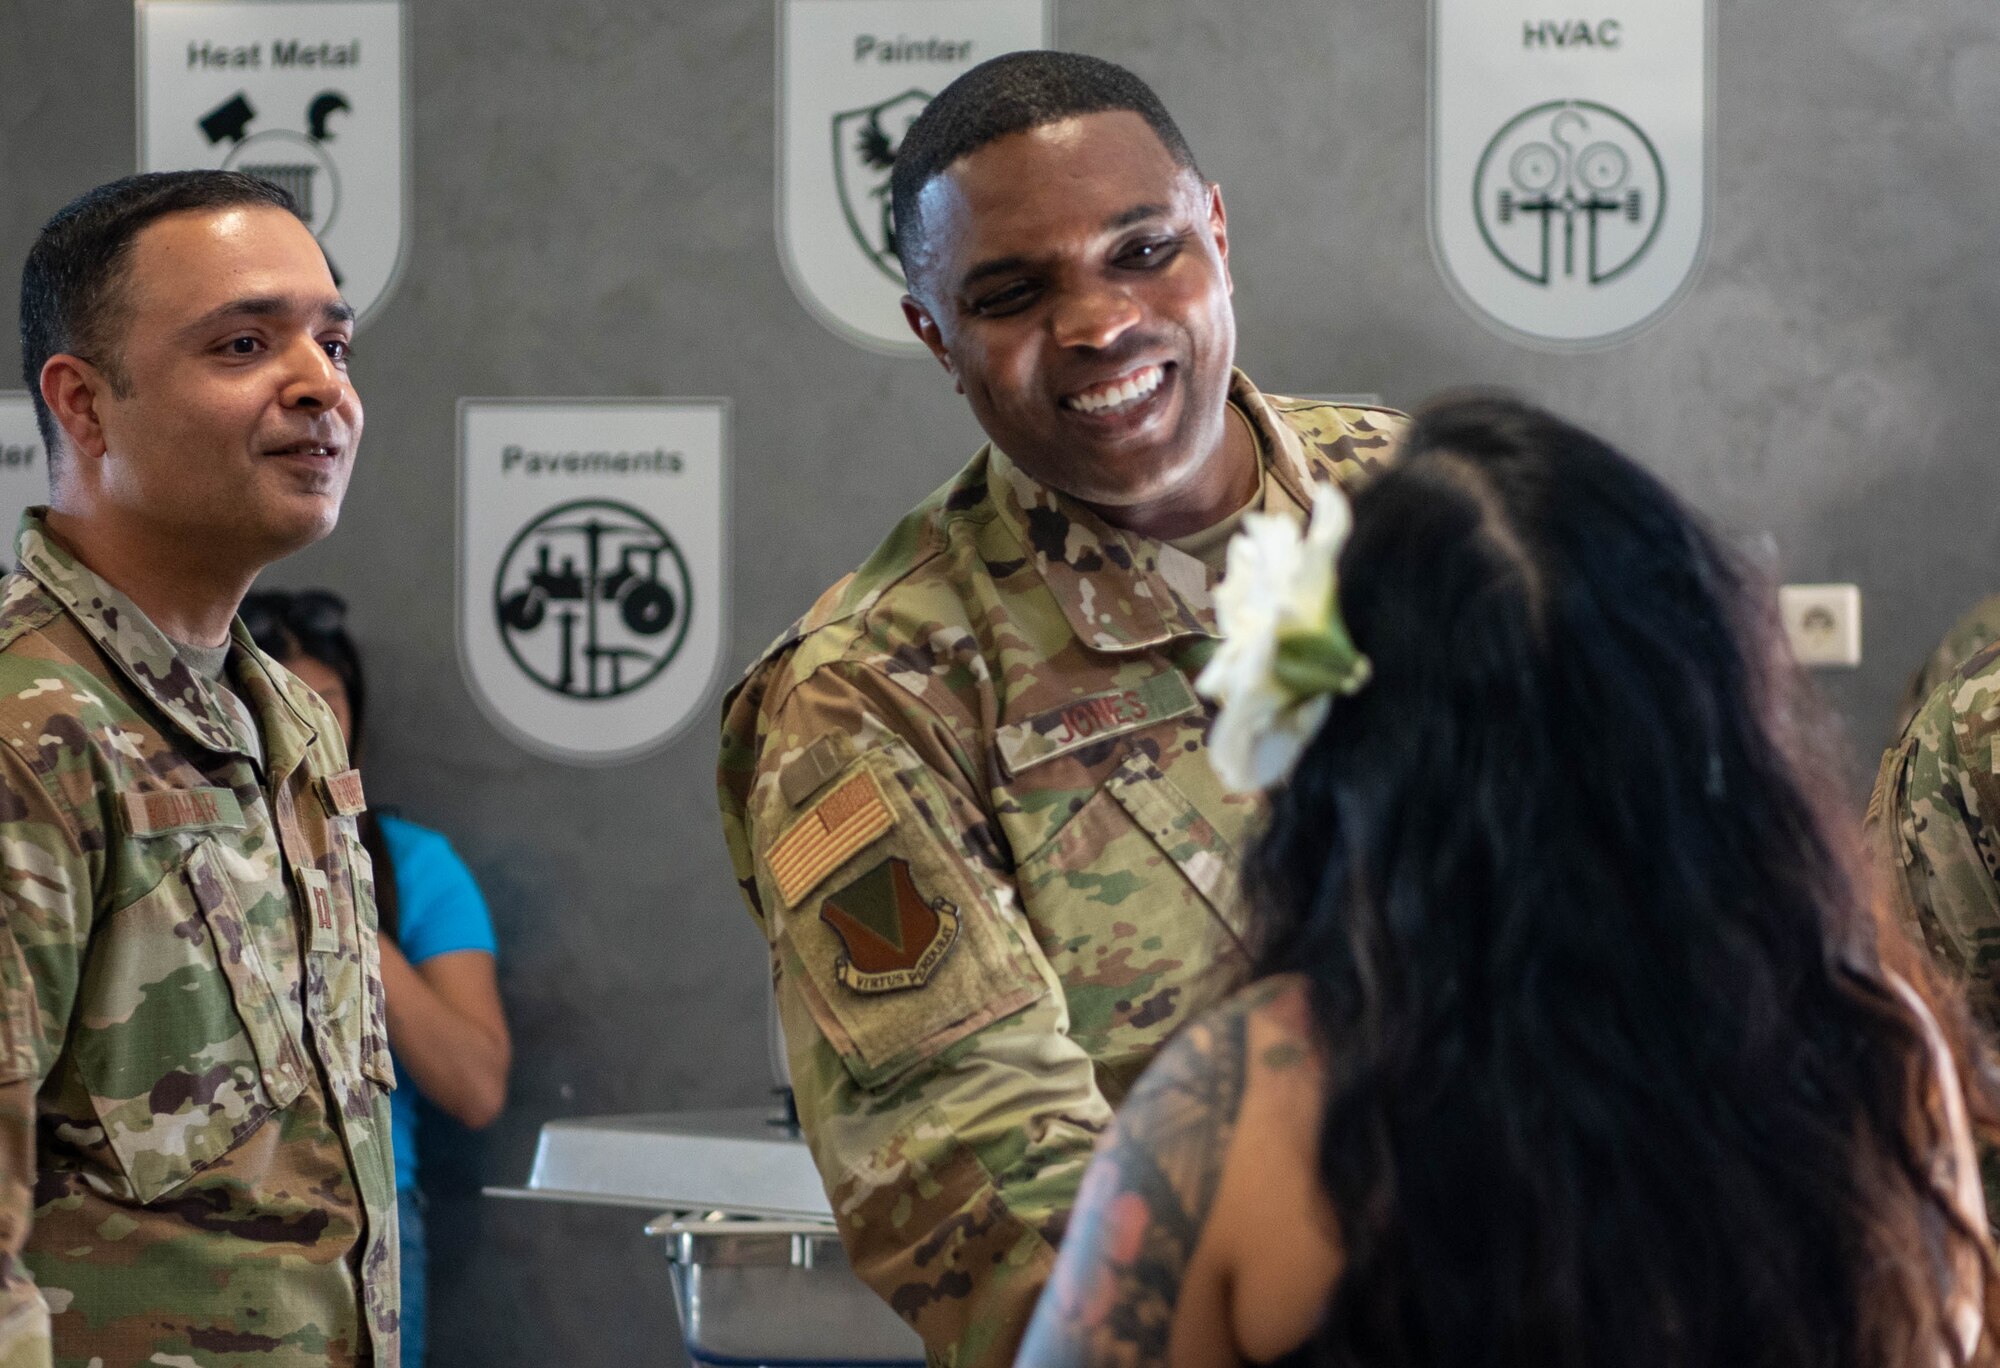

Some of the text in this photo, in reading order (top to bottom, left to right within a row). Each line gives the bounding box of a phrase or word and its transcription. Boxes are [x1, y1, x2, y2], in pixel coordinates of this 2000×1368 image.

[855, 33, 972, 62] Painter
[1522, 18, 1621, 48] HVAC
[187, 38, 361, 69] Heat Metal
[502, 444, 687, 474] Pavements
[1057, 690, 1148, 743] JONES
[855, 973, 905, 988] VIRTUS
